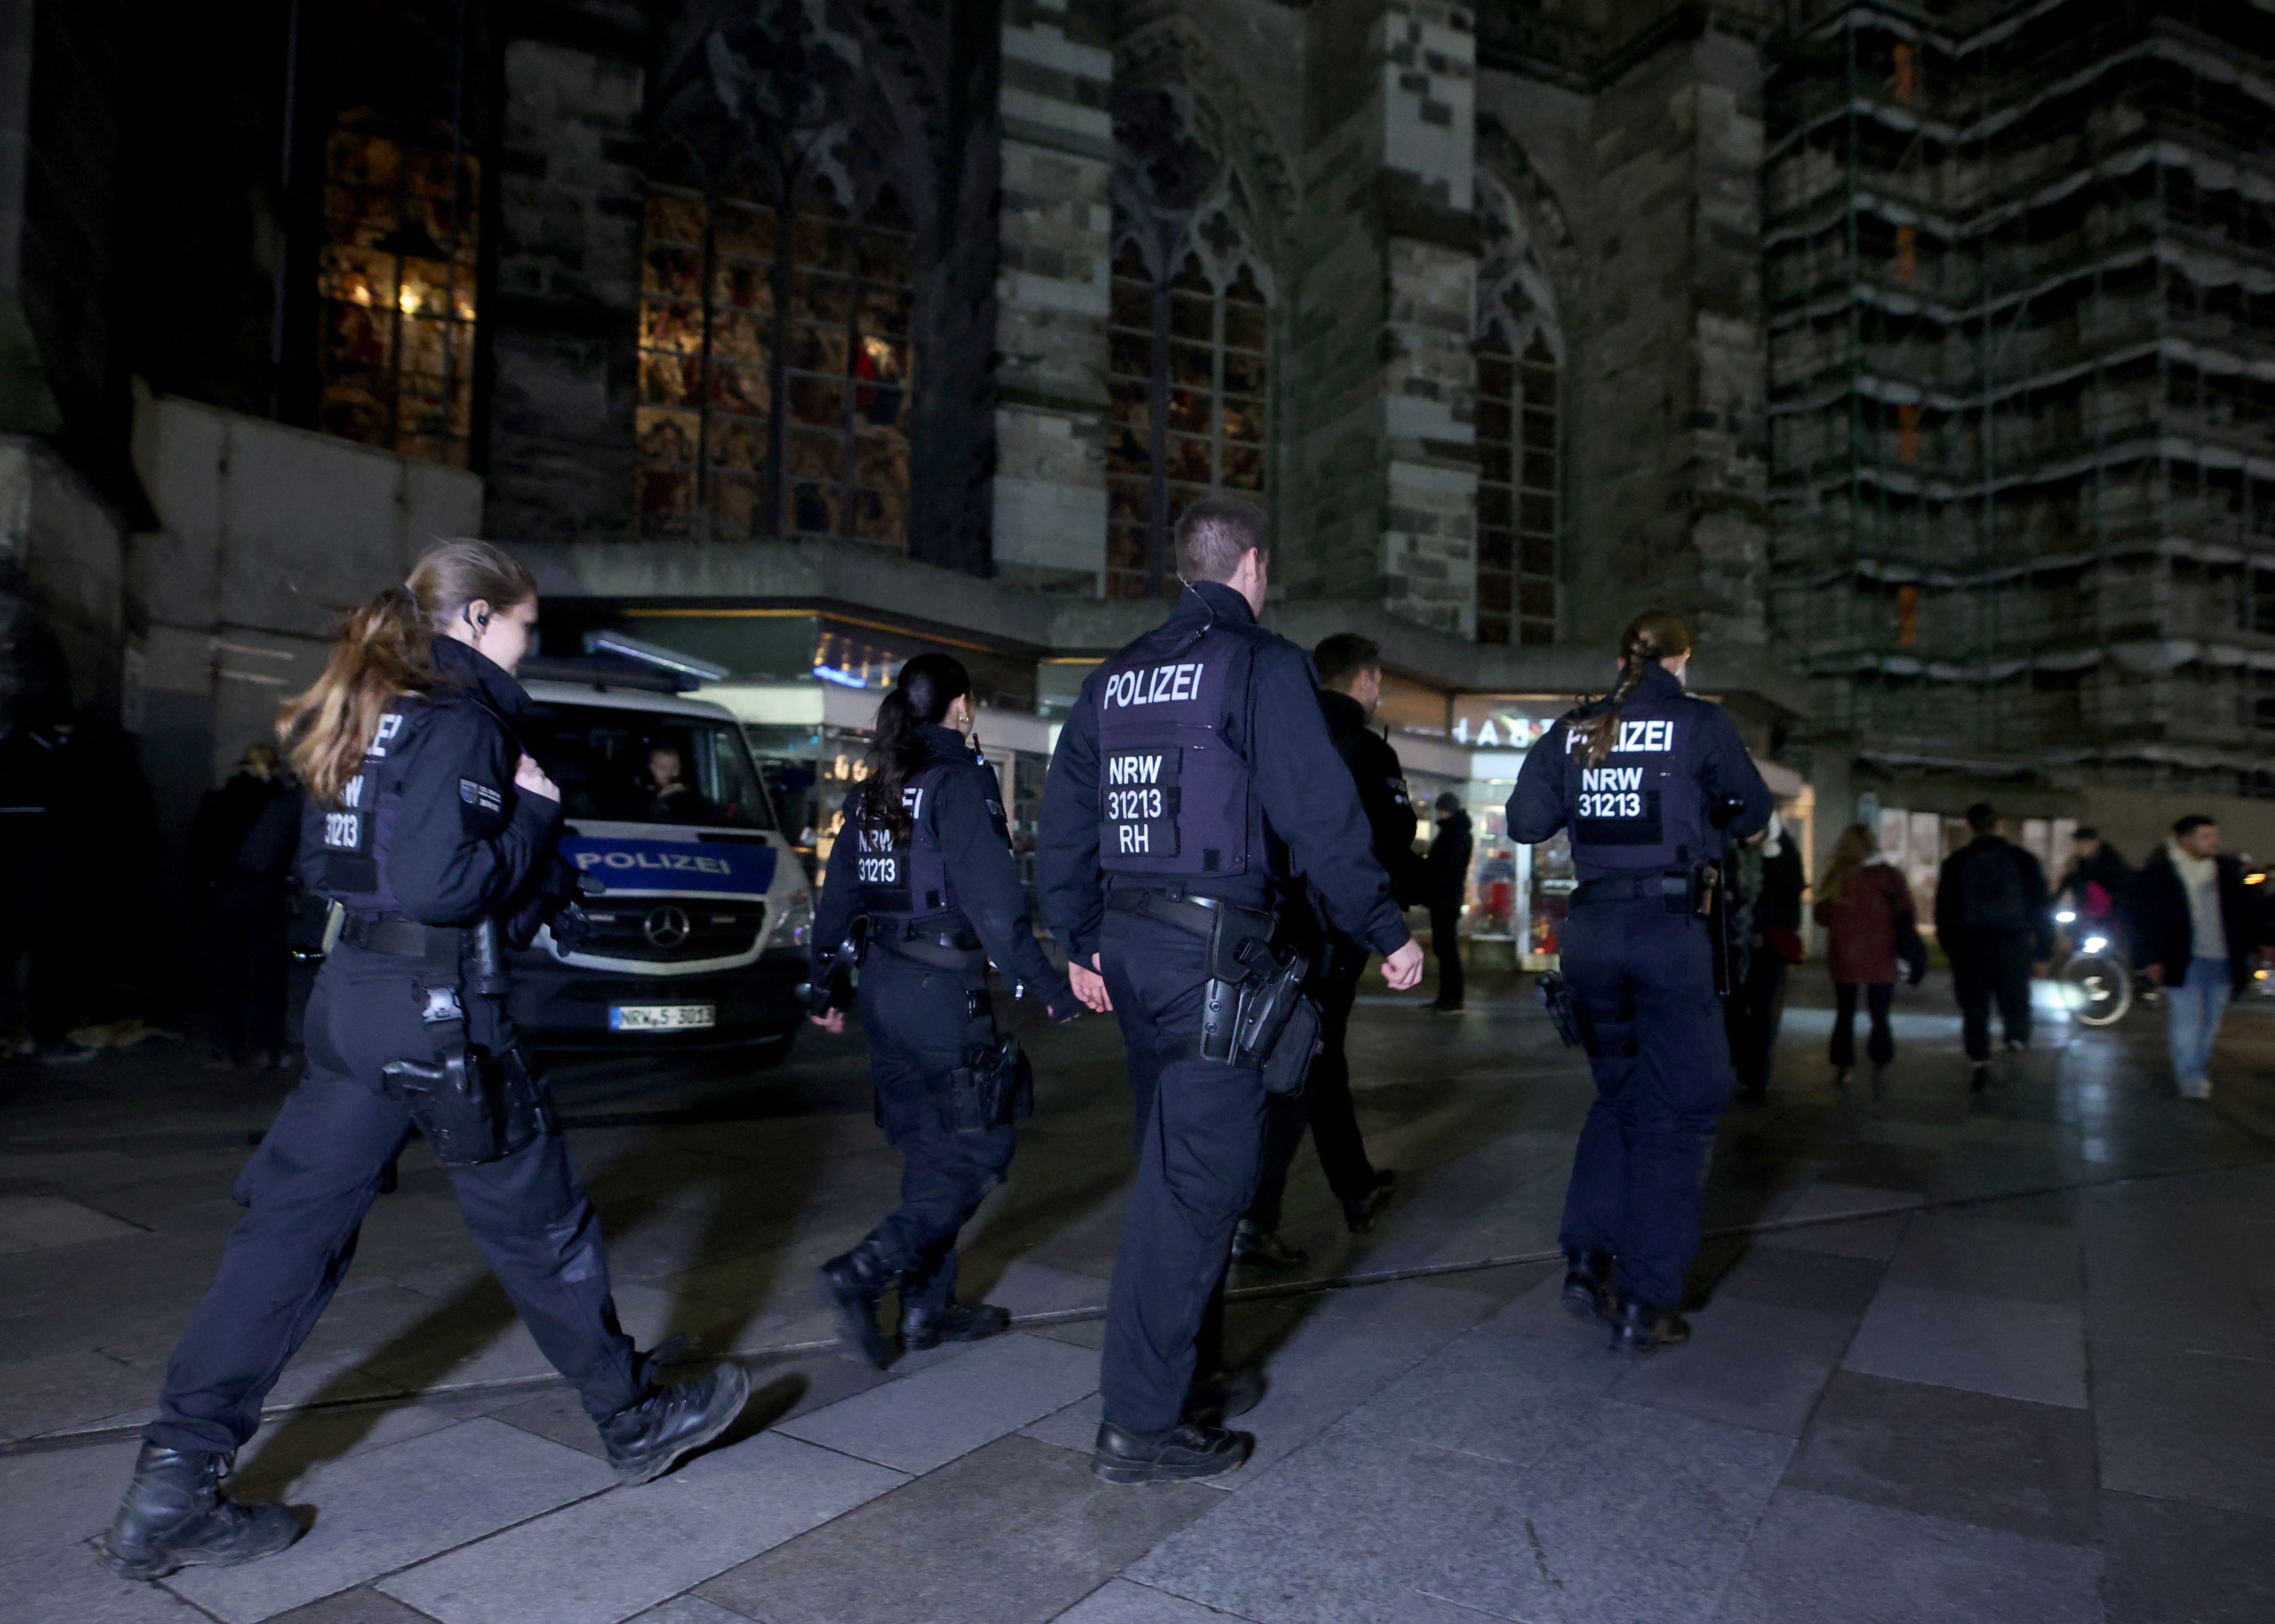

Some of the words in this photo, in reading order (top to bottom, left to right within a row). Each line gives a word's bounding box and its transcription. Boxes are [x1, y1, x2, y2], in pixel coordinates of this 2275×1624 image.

[1103, 663, 1204, 710] POLIZEI
[1109, 755, 1163, 785] NRW
[1582, 767, 1644, 791] NRW
[1108, 788, 1162, 820] 31213
[1578, 793, 1641, 817] 31213
[1119, 824, 1149, 853] RH
[574, 852, 731, 875] POLIZEI
[858, 858, 896, 883] 31213
